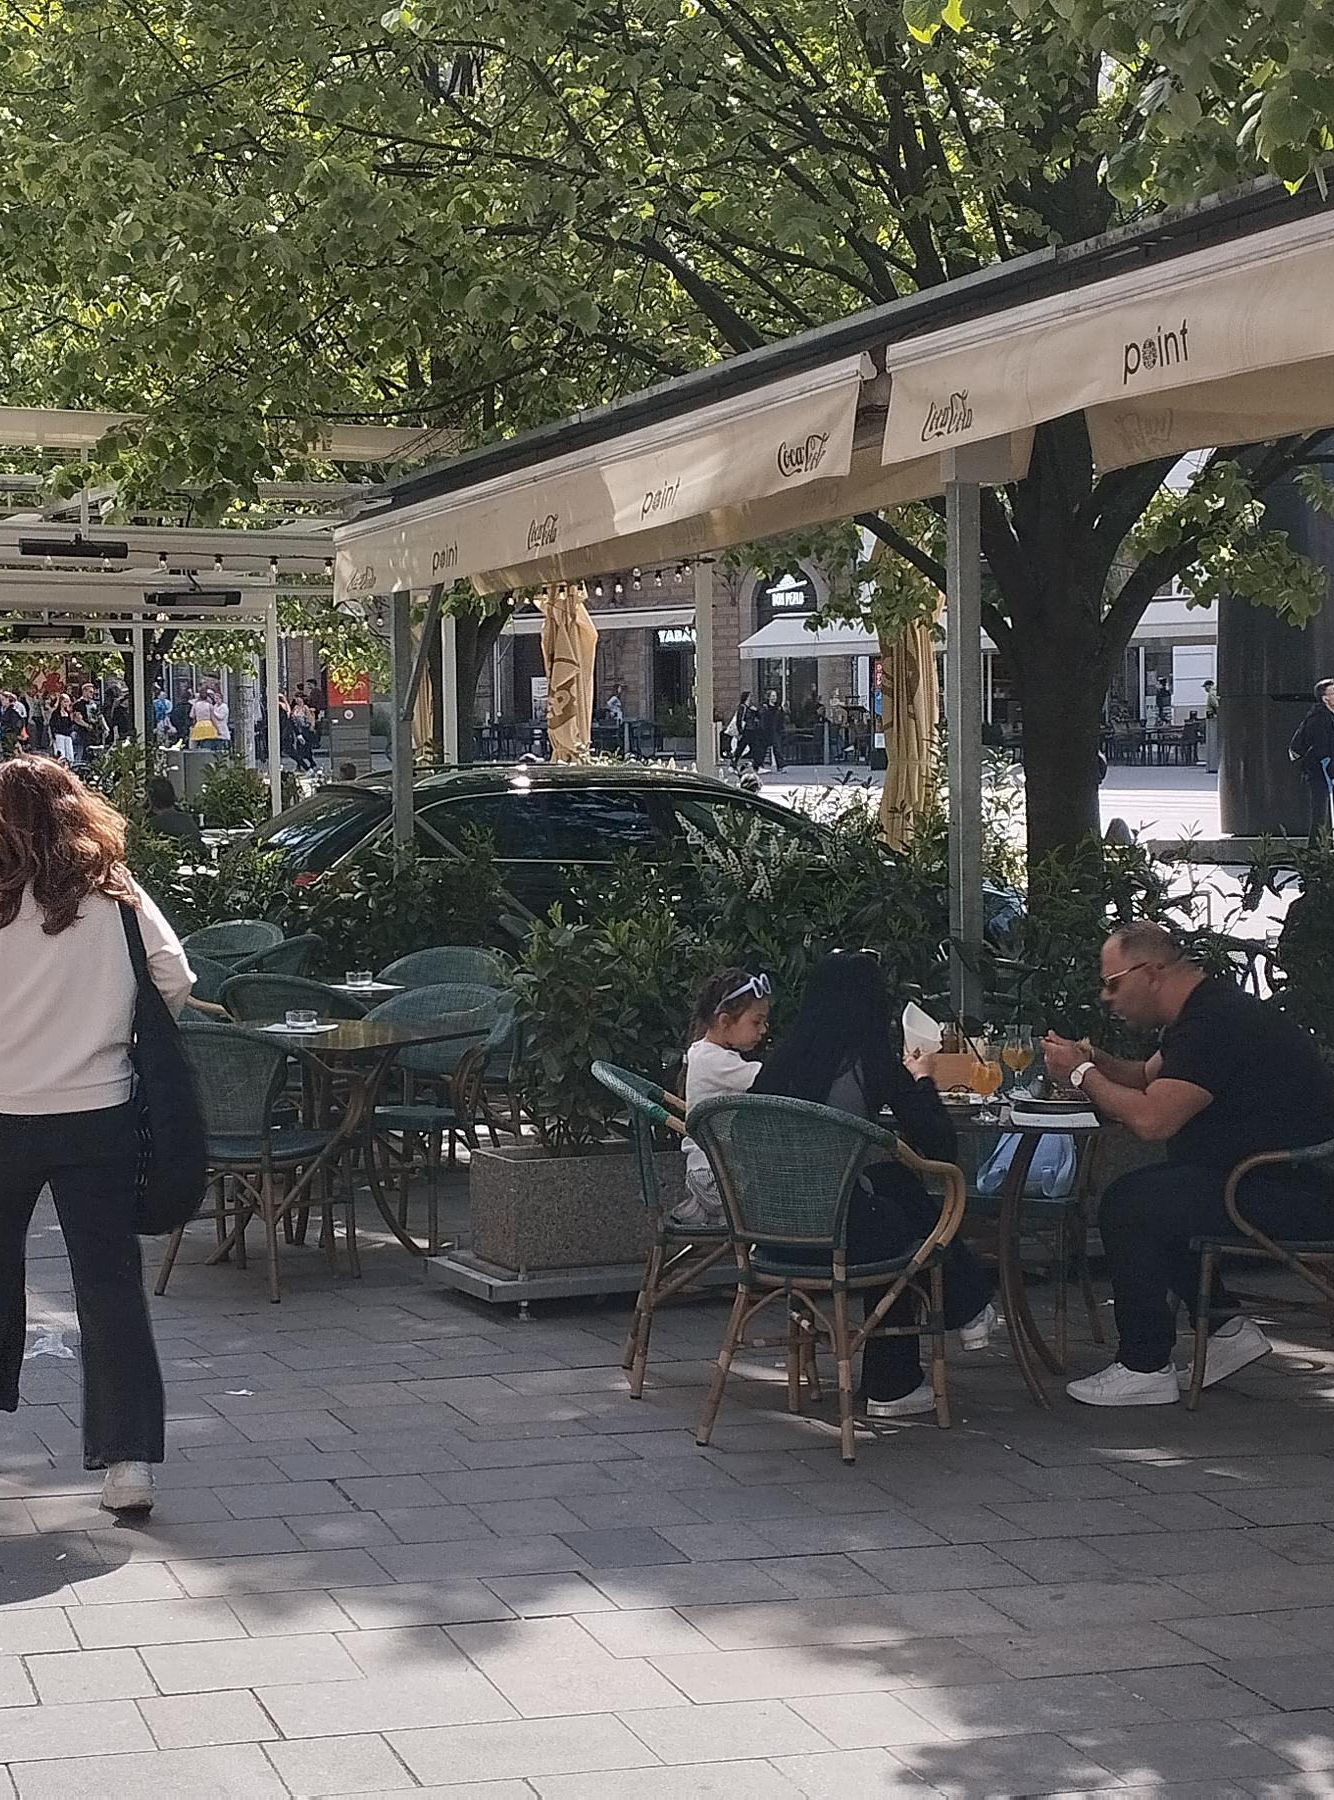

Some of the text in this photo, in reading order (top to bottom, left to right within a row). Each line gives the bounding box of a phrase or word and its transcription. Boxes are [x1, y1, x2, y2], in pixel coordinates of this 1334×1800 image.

[1123, 319, 1188, 385] point
[640, 476, 680, 521] point
[432, 540, 458, 576] point
